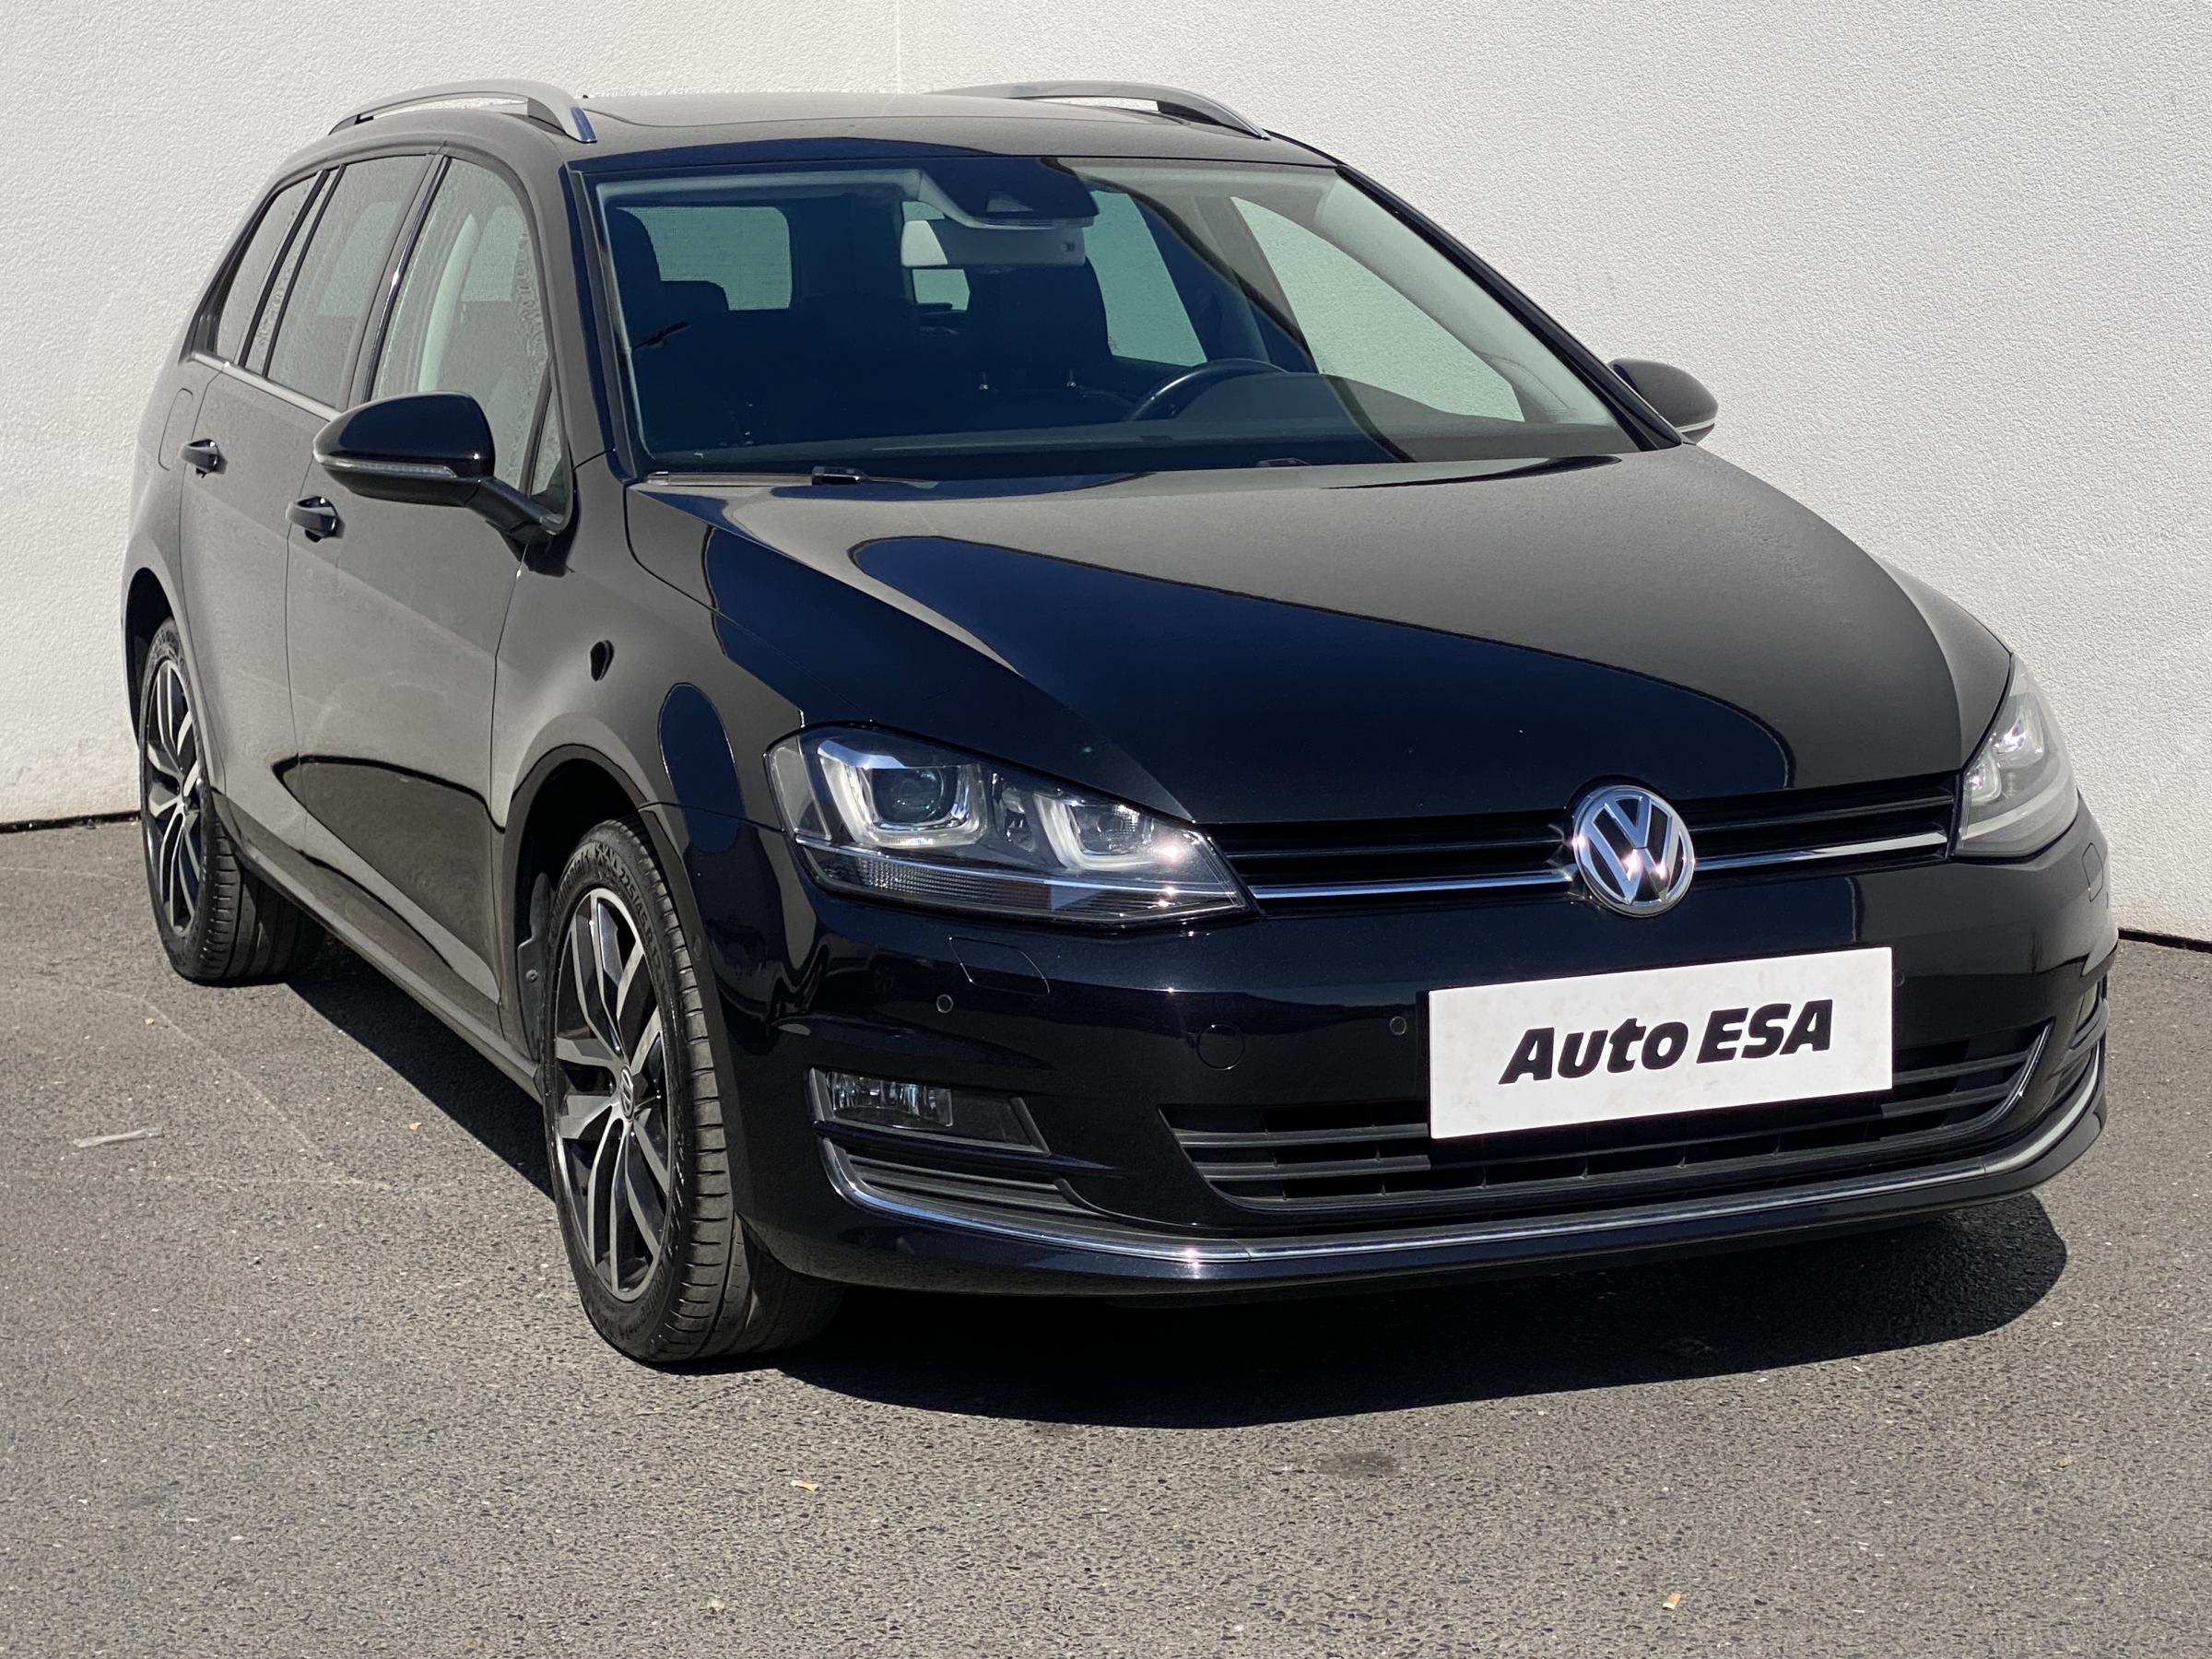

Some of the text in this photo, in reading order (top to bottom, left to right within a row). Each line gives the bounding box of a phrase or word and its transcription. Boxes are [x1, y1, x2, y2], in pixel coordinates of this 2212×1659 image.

[1576, 789, 1692, 914] VW
[1499, 1000, 1832, 1084] Auto ESA
